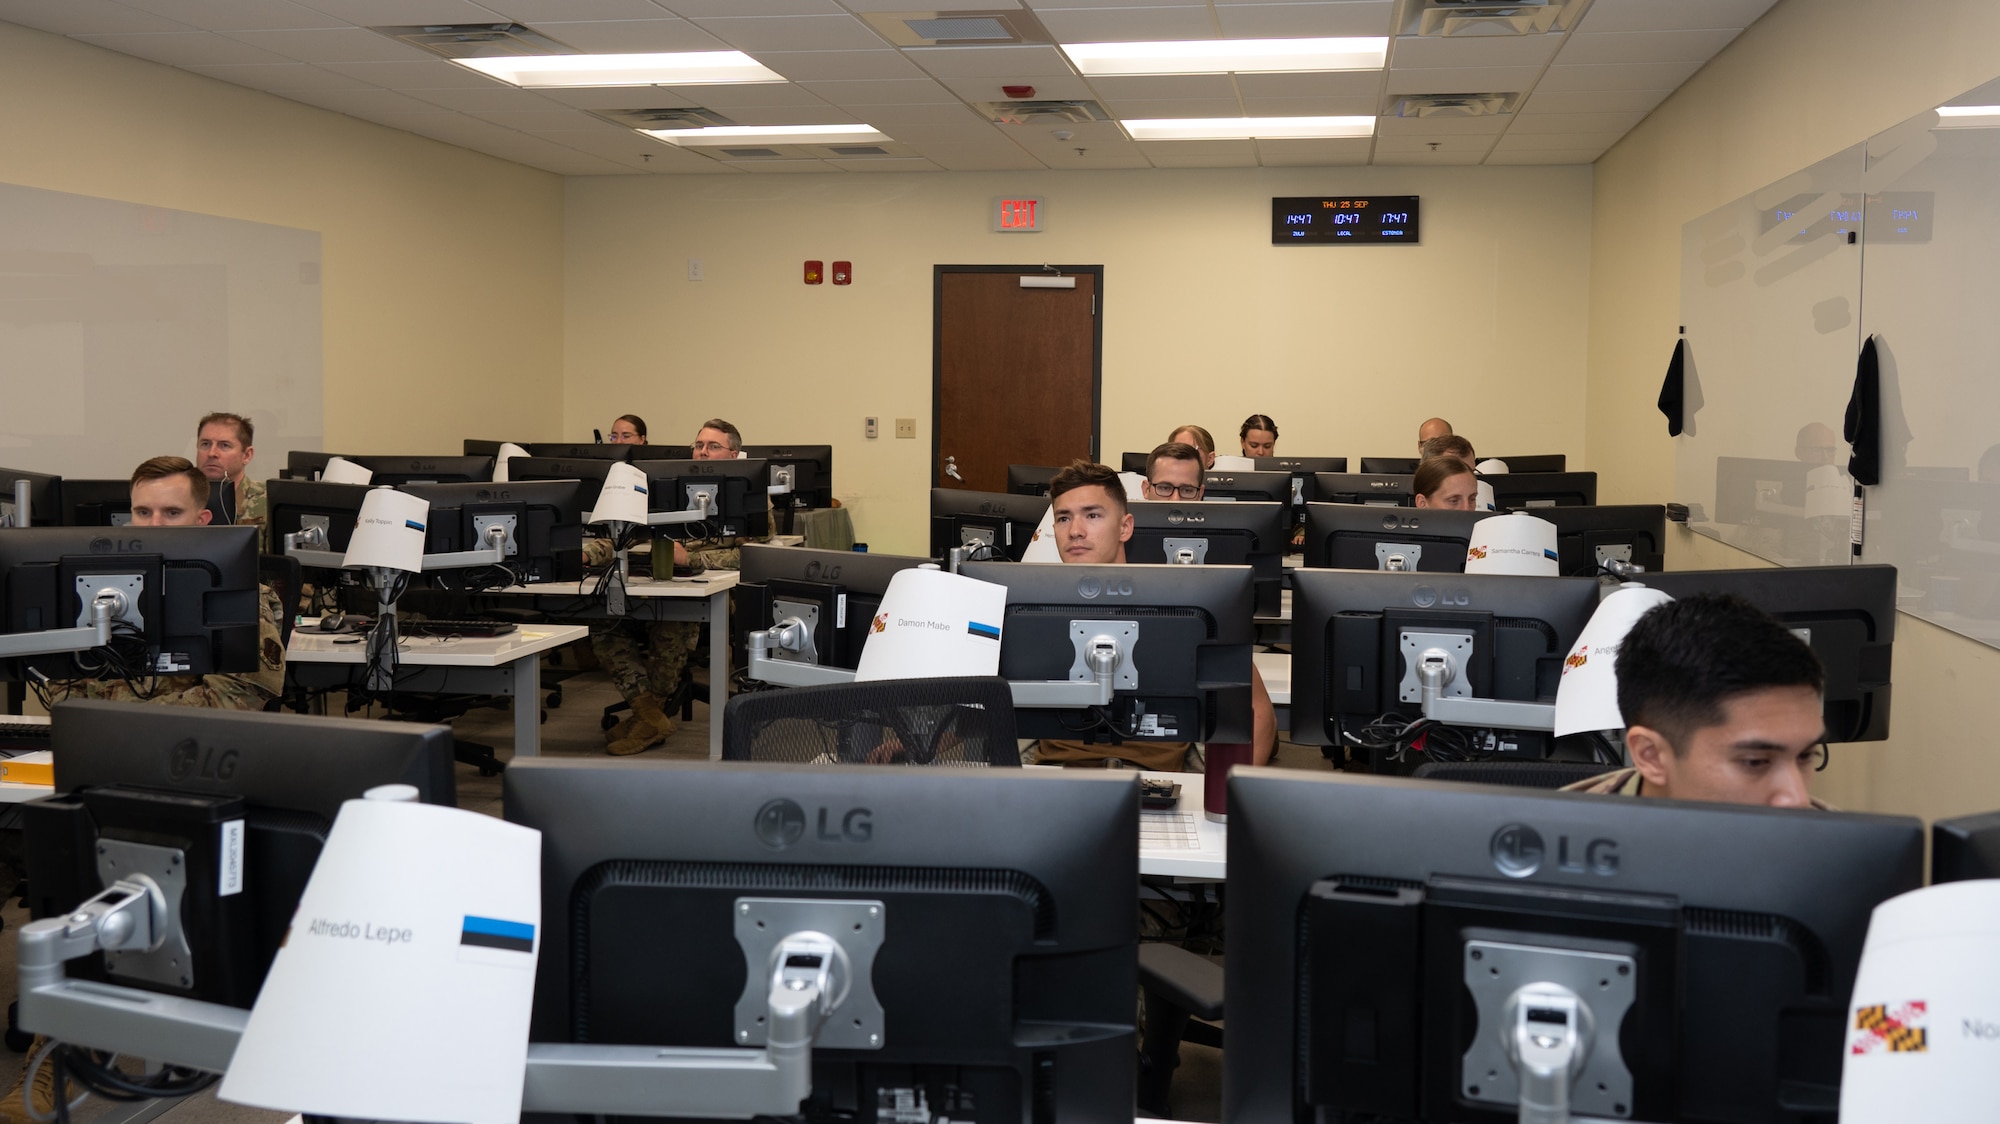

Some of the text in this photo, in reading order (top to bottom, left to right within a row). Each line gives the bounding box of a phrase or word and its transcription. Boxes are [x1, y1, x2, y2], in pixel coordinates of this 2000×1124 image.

[1002, 200, 1037, 228] EXIT
[1322, 201, 1336, 209] THU
[1286, 214, 1312, 224] 14:47
[1334, 213, 1360, 224] 10:47
[1381, 213, 1408, 224] 17:47
[822, 565, 842, 580] LG
[1106, 575, 1134, 596] LG
[1441, 588, 1470, 606] LG
[898, 618, 951, 631] Damon Mabe
[201, 747, 240, 780] LG
[816, 806, 873, 843] LG
[1557, 835, 1619, 876] LG
[309, 918, 413, 946] Alfredo Lepe
